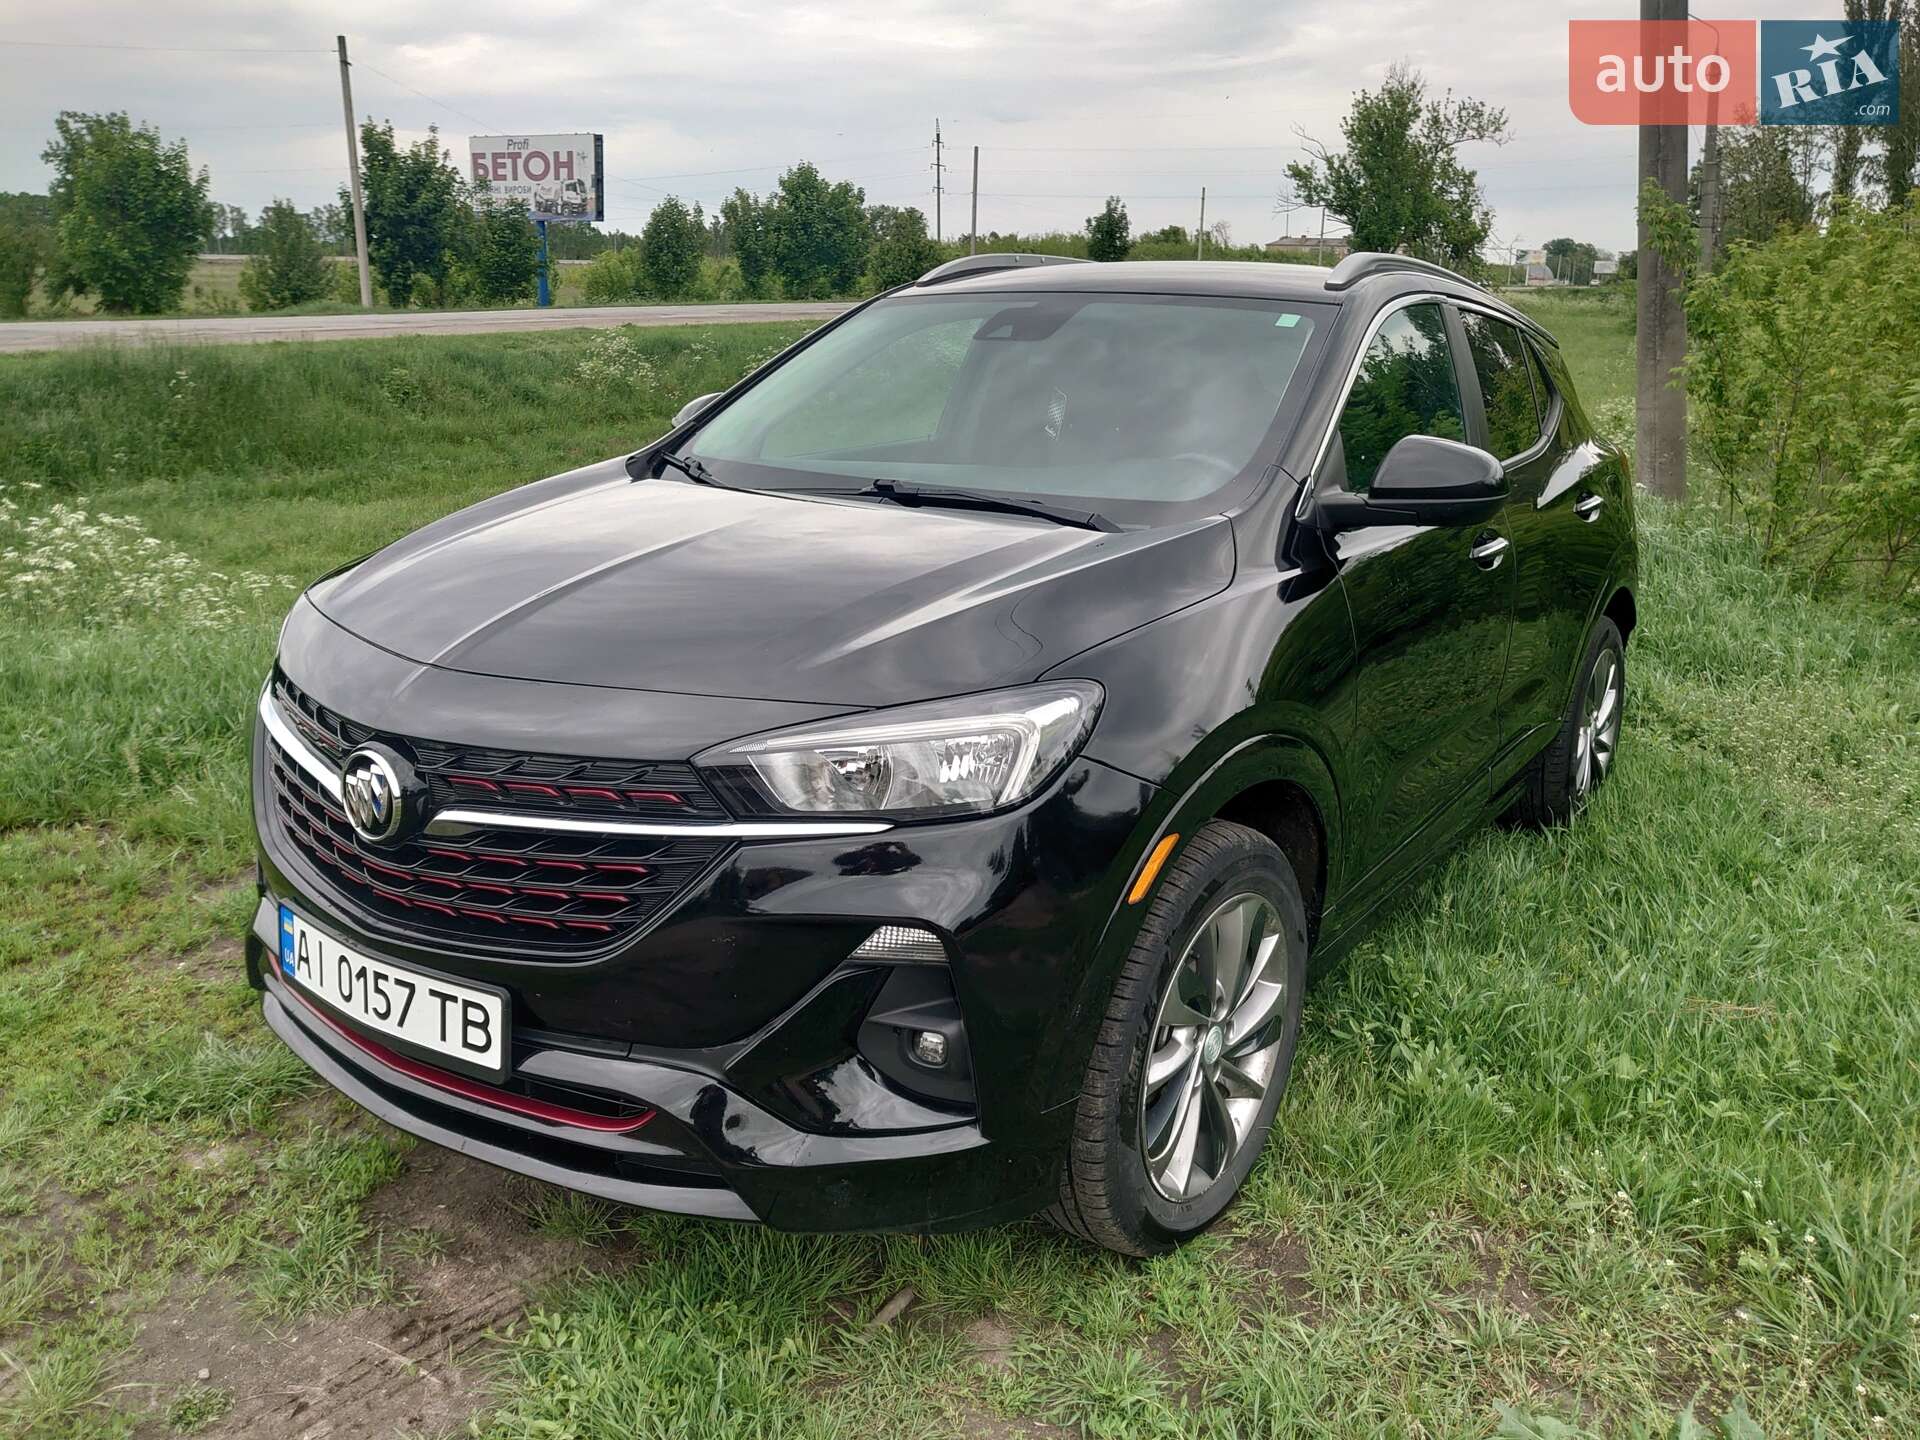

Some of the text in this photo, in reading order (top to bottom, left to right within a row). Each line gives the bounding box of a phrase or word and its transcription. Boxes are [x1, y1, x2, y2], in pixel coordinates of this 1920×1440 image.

[506, 138, 529, 150] Profi
[472, 150, 574, 182] БЕТОН
[284, 947, 295, 968] UA
[297, 930, 492, 1054] AI 0157 TB
